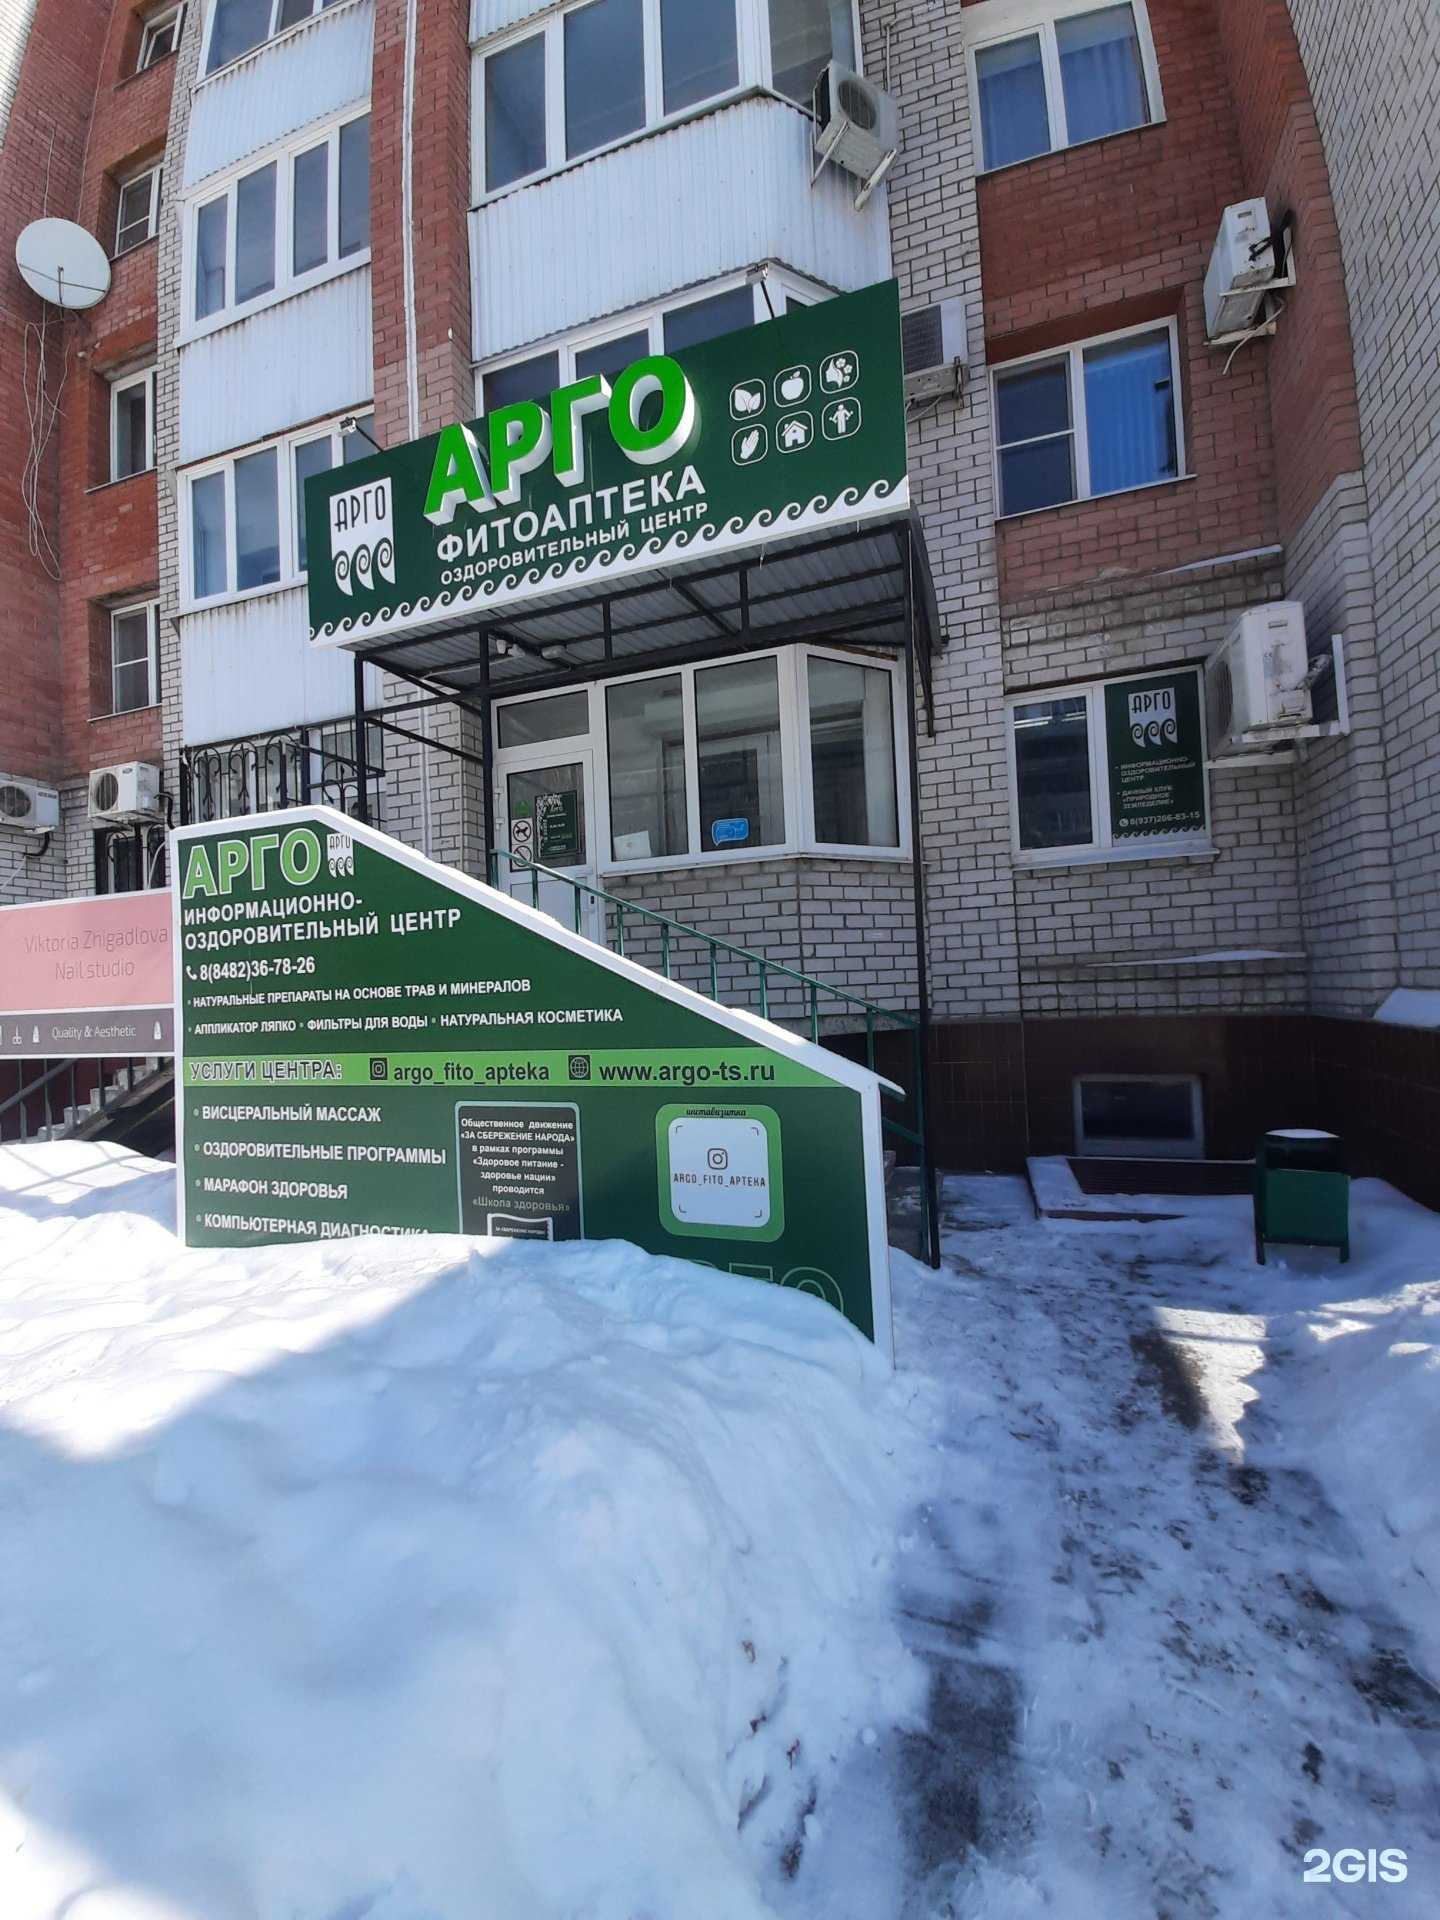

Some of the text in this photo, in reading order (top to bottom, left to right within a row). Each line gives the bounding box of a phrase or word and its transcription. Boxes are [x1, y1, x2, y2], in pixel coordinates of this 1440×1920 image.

[424, 355, 695, 526] АРГО
[334, 484, 386, 533] АРГО
[436, 465, 706, 563] ФИТОАПТЕКА
[441, 502, 708, 585] ОЗДОРОВИТЕЛЬНЫЙ ЦЕНТР
[1132, 690, 1171, 714] АРГО
[182, 828, 322, 900] АРГО
[184, 891, 363, 925] ИНФОРМАЦИОННО-
[185, 908, 461, 950] ОЗДОРОВИТЕЛЬНЫЙ ЦЕНТР
[56, 960, 135, 980] Nail studio
[200, 956, 315, 983] 8(8482)36-78-26
[193, 979, 531, 1008] НАТУРАЛЬНЫЕ ПРЕПАРАТЫ НА ОСНОВЕ ТРАВ И МИНЕРАЛОВ
[52, 1024, 136, 1040] Quality & Aesthetic
[194, 1008, 623, 1035] АППЛИКАТОР ЛЯПКО ФИЛЬТРЫ ДЛЯ ВОДЫ НАТУРАЛЬНАЯ КОСМЕТИКА
[190, 1058, 342, 1083] УСЛУГИ ЦЕНТРА:
[393, 1061, 550, 1085] argo_fito_apteka
[599, 1061, 775, 1085] www.argo-ts.ru
[202, 1103, 382, 1122] ВИСЦЕРАЛЬНЫЙ МАССАЖ
[461, 1118, 574, 1129] Общественное движение
[461, 1131, 575, 1143] «ЗА СБЕРЕЖЕНИЕ НАРОДА»
[203, 1142, 446, 1165] ОЗДОРОВИТЕЛЬНЫЕ ПРОГРАММЫ
[473, 1156, 519, 1167] «Здоровое
[522, 1160, 558, 1169] питание
[480, 1146, 510, 1154] рамках
[512, 1147, 564, 1156] программы
[203, 1177, 348, 1199] МАРАФОН ЗДОРОВЬЯ
[481, 1172, 556, 1182] здоровье нации»
[473, 1196, 511, 1207] «Школа
[492, 1185, 544, 1194] проводится
[204, 1212, 317, 1236] КОМПЬЮТЕРНАЯ
